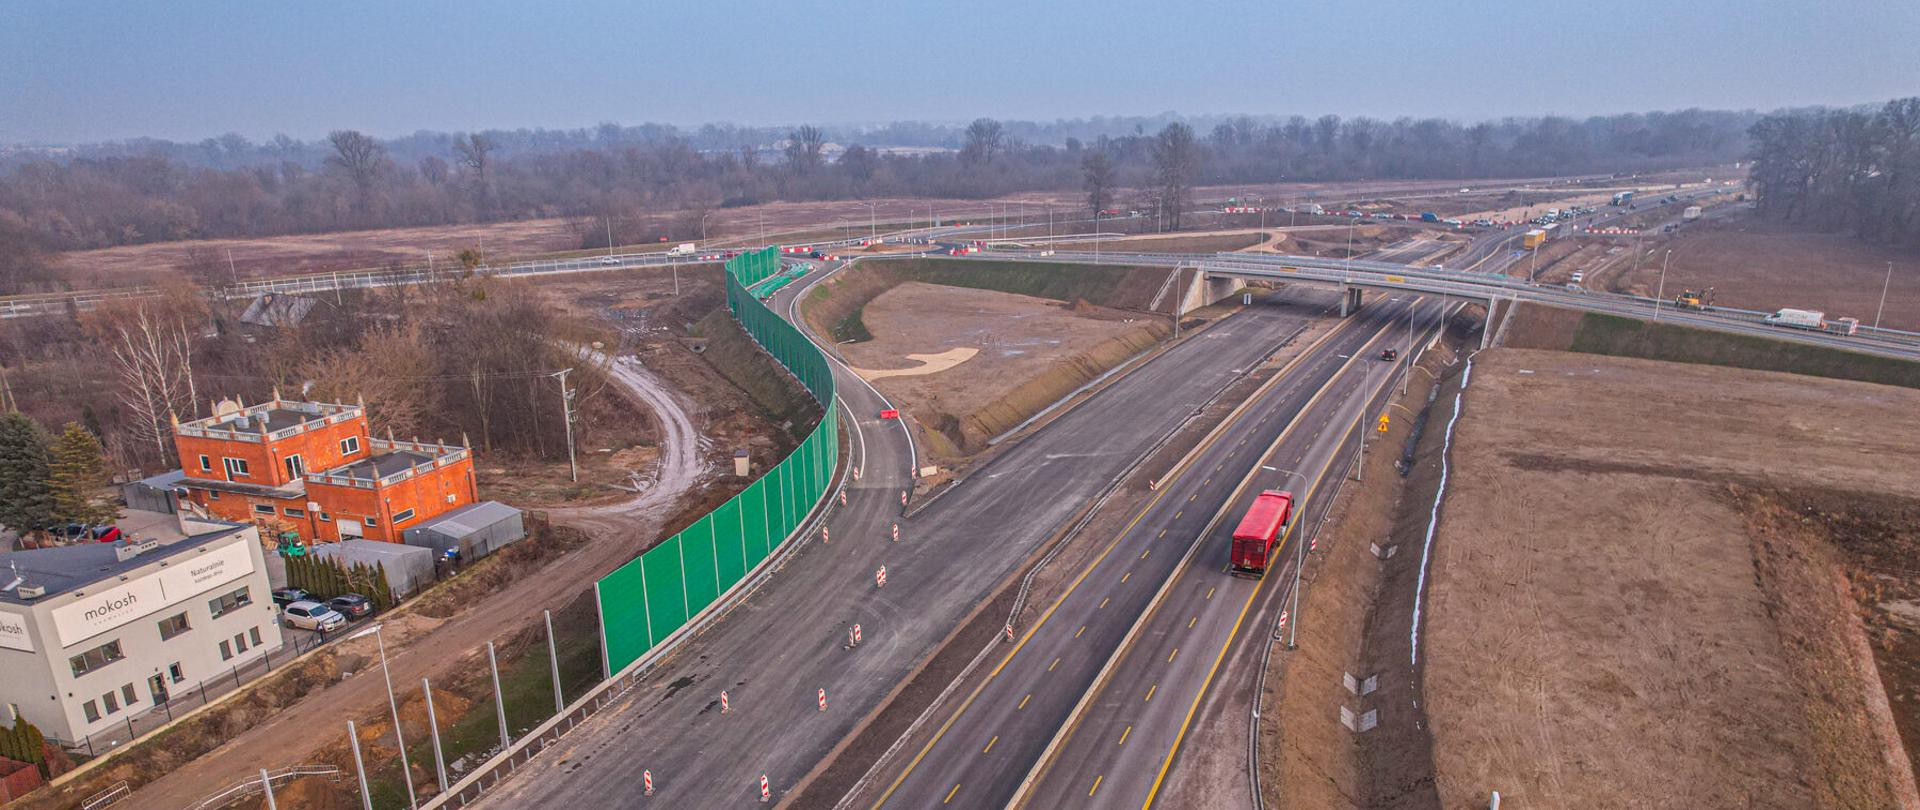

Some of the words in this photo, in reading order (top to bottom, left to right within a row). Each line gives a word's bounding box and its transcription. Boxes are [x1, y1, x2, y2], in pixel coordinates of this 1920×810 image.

[190, 560, 224, 577] Naturalnie
[84, 592, 137, 621] mokosh
[0, 620, 23, 635] kosh
